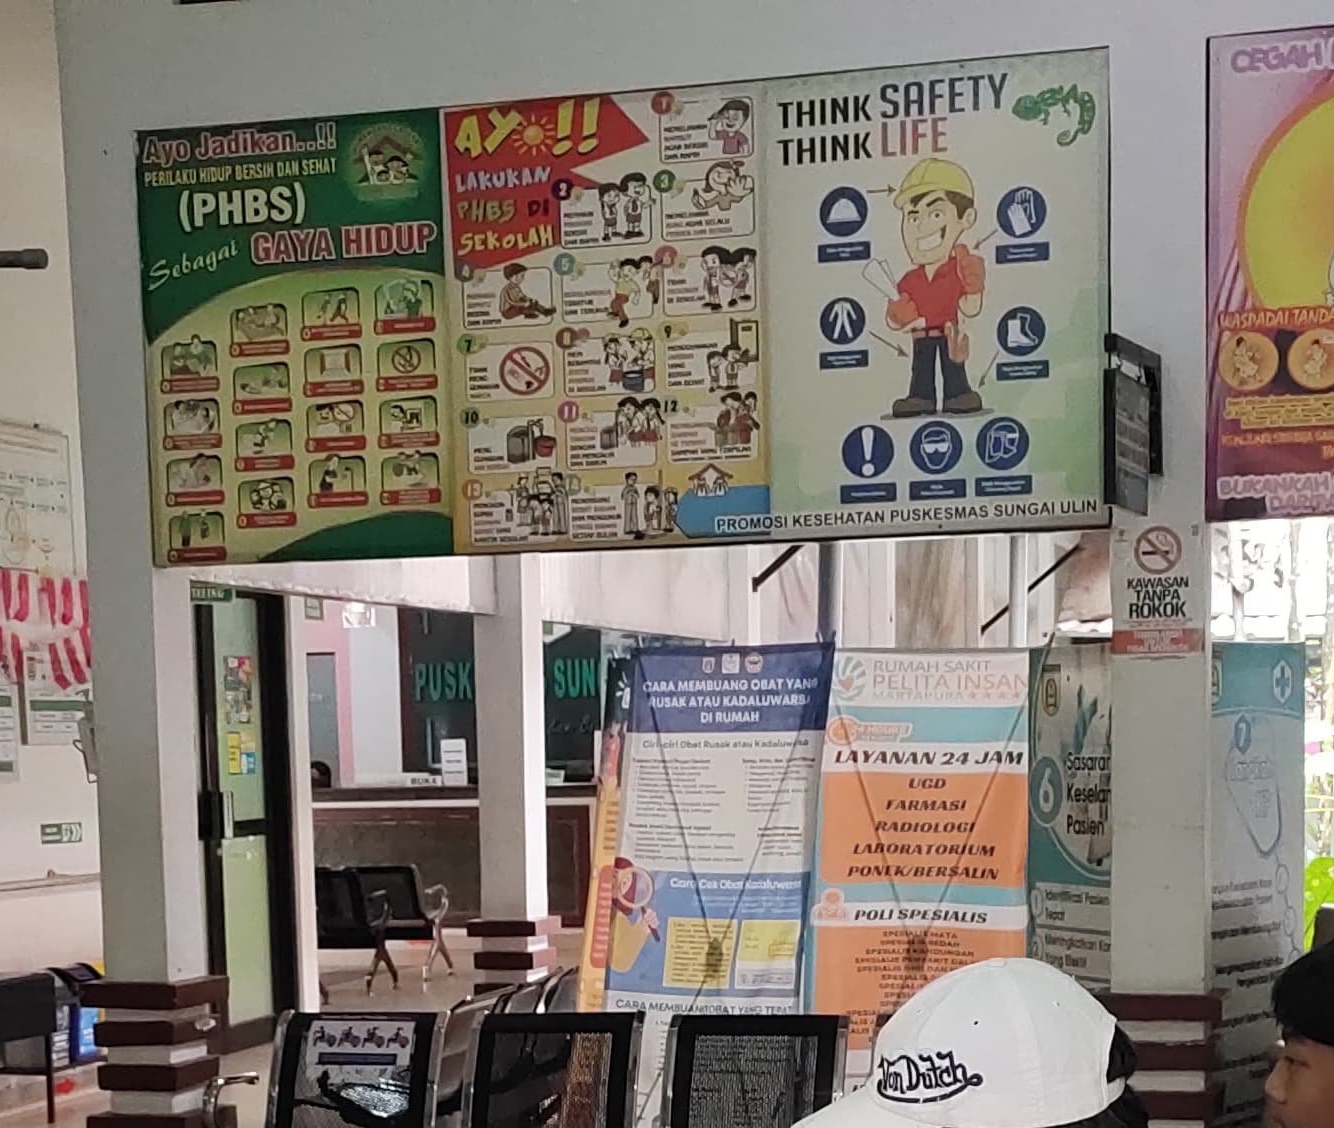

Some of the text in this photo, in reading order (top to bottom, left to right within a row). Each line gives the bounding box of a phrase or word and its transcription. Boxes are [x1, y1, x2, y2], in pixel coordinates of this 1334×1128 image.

[1230, 43, 1322, 73] CEGAH
[777, 73, 1008, 129] THINK SAFETY
[142, 134, 191, 168] Ayo
[777, 117, 948, 166] THINK LIFE
[144, 157, 337, 188] PERILAKU HIDUP BERSIH DAN SEHAT
[455, 167, 551, 192] LAKUKAN
[178, 181, 306, 232] (PHBS)
[458, 200, 549, 223] PHBS DI
[251, 221, 437, 265] GAYA HIDUP
[458, 225, 554, 256] SEKOLAH
[147, 240, 239, 291] Sebagai
[717, 499, 1097, 532] PROMOSI KESEHATAN PUSKESMAS SUNGAI ULIN
[1127, 576, 1189, 590] KAWASAN
[1134, 589, 1181, 603] TANPA
[1129, 601, 1187, 620] ROKOK
[873, 660, 991, 673] RUMAH SAKIT
[643, 681, 675, 693] CARA
[676, 680, 748, 692] MEMBUANG
[750, 679, 784, 690] OBAT
[873, 675, 952, 690] PELITA
[689, 696, 719, 707] ATAU
[700, 711, 759, 723] DI RUMAH
[834, 750, 1023, 766] LAYANAN 24 JAM
[908, 778, 946, 789] UGD
[1038, 768, 1054, 811] 6
[886, 800, 967, 811] FARMASI
[874, 821, 975, 833] RADIOLOGI
[1067, 815, 1105, 835] Pasien
[853, 843, 995, 857] LABORATORIUM
[847, 866, 999, 880] PONEK/BERSALIN
[854, 909, 988, 924] POLI SPESIALIS
[878, 1051, 967, 1094] Von Dutch
